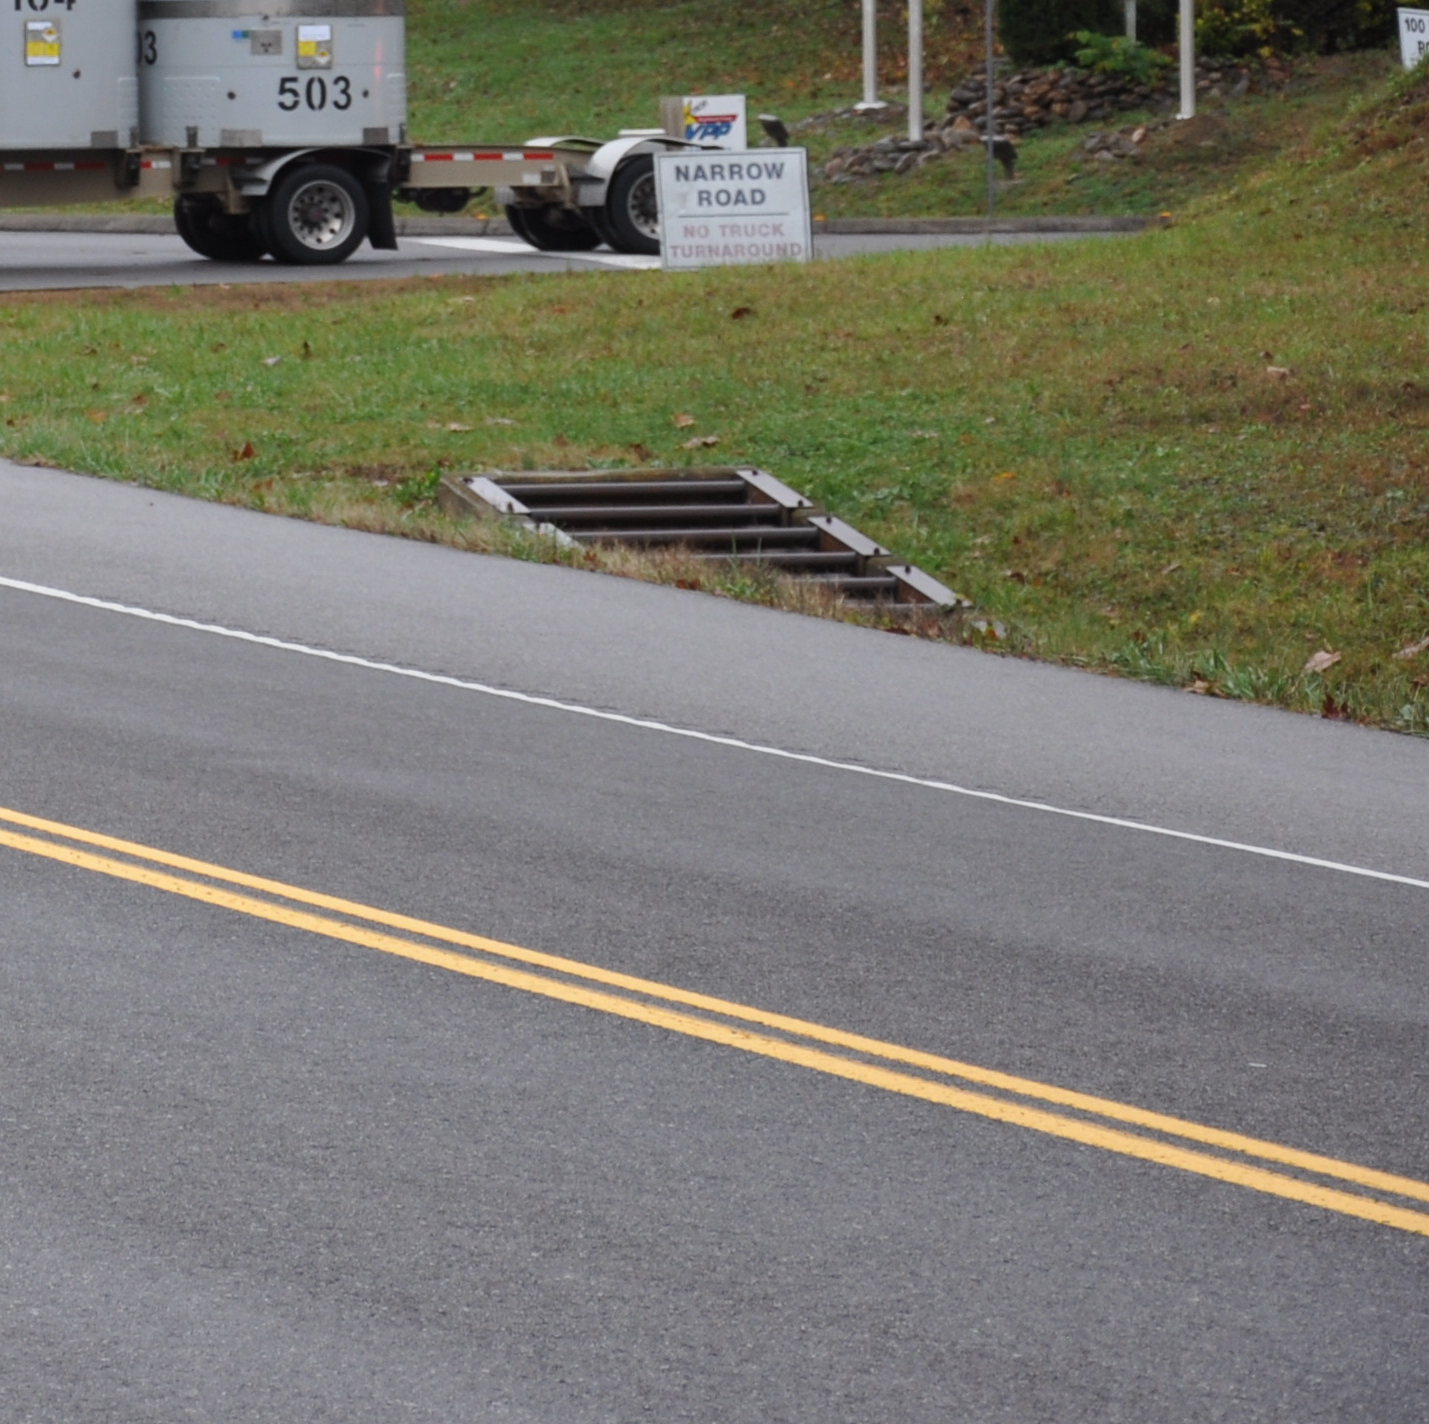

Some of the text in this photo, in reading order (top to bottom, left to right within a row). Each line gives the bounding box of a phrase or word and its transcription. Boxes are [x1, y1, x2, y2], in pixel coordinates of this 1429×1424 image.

[278, 76, 352, 111] 503
[675, 162, 785, 182] NARROW
[697, 189, 766, 207] ROAD
[683, 223, 785, 238] NO TRUCK
[670, 243, 802, 258] TURNAROUND
